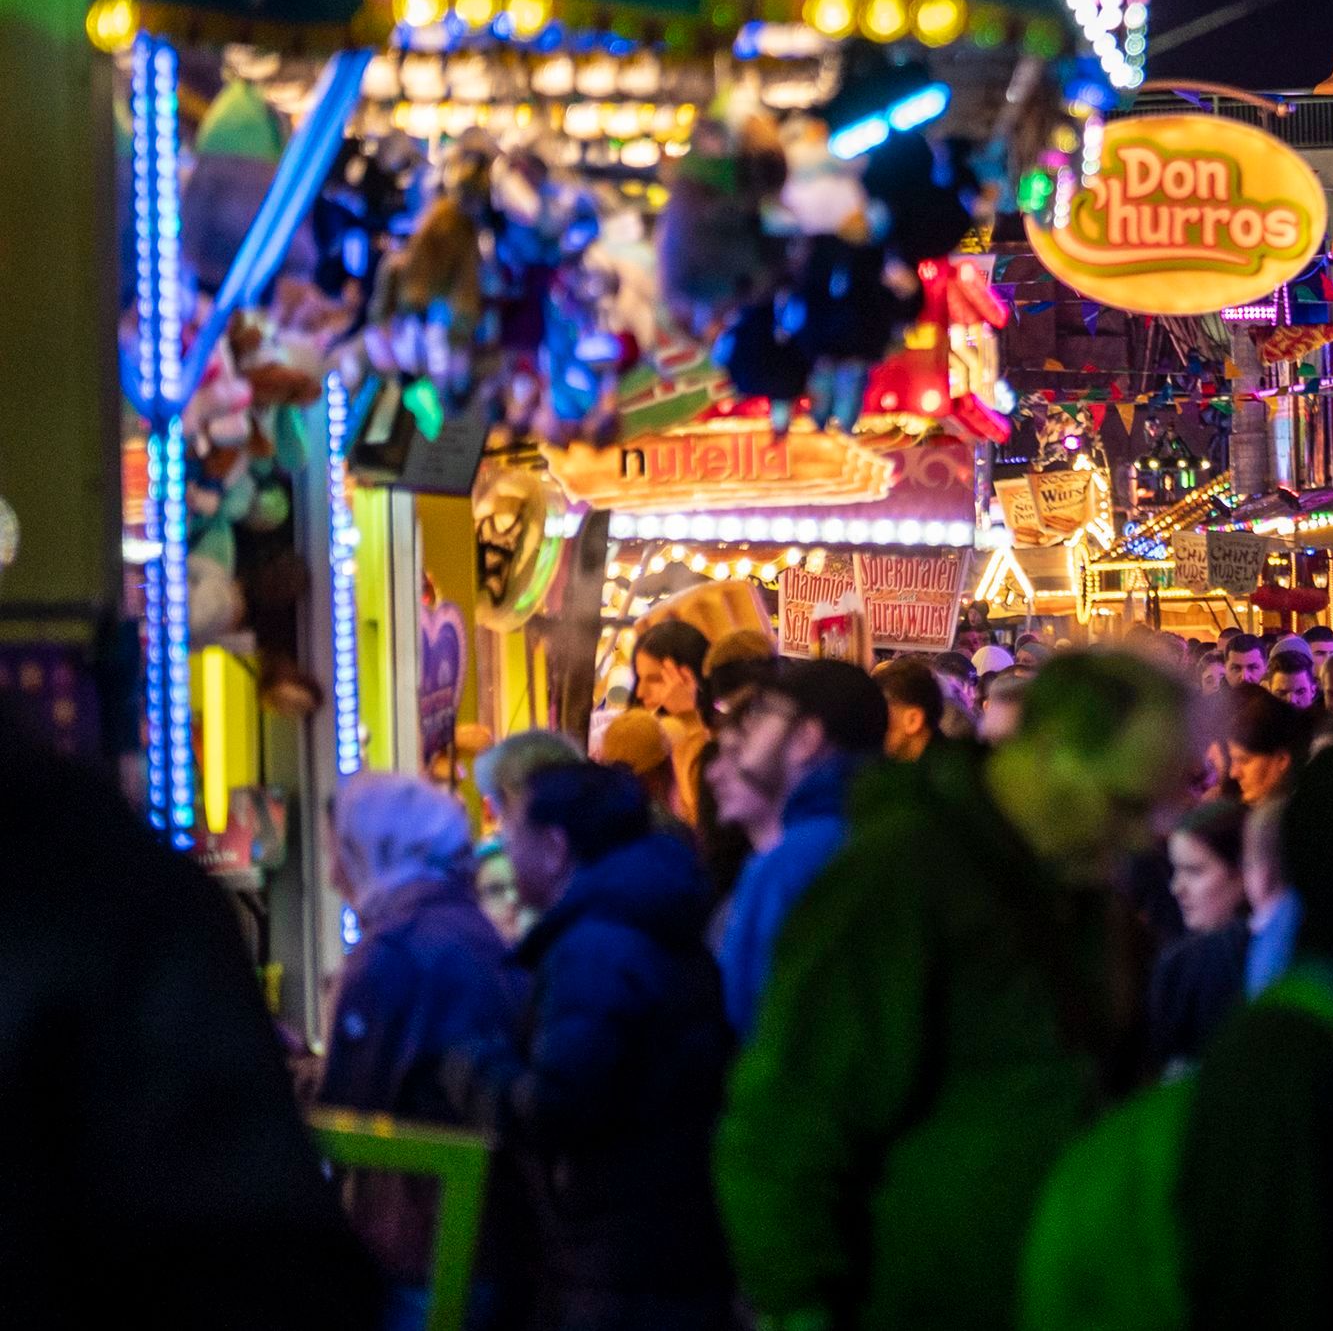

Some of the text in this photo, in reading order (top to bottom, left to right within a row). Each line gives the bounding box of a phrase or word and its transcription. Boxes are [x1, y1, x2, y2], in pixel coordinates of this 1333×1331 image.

[1117, 147, 1228, 201] Don
[620, 432, 791, 479] nutella
[1211, 546, 1259, 565] CHINA
[1211, 564, 1257, 581] NUDELN
